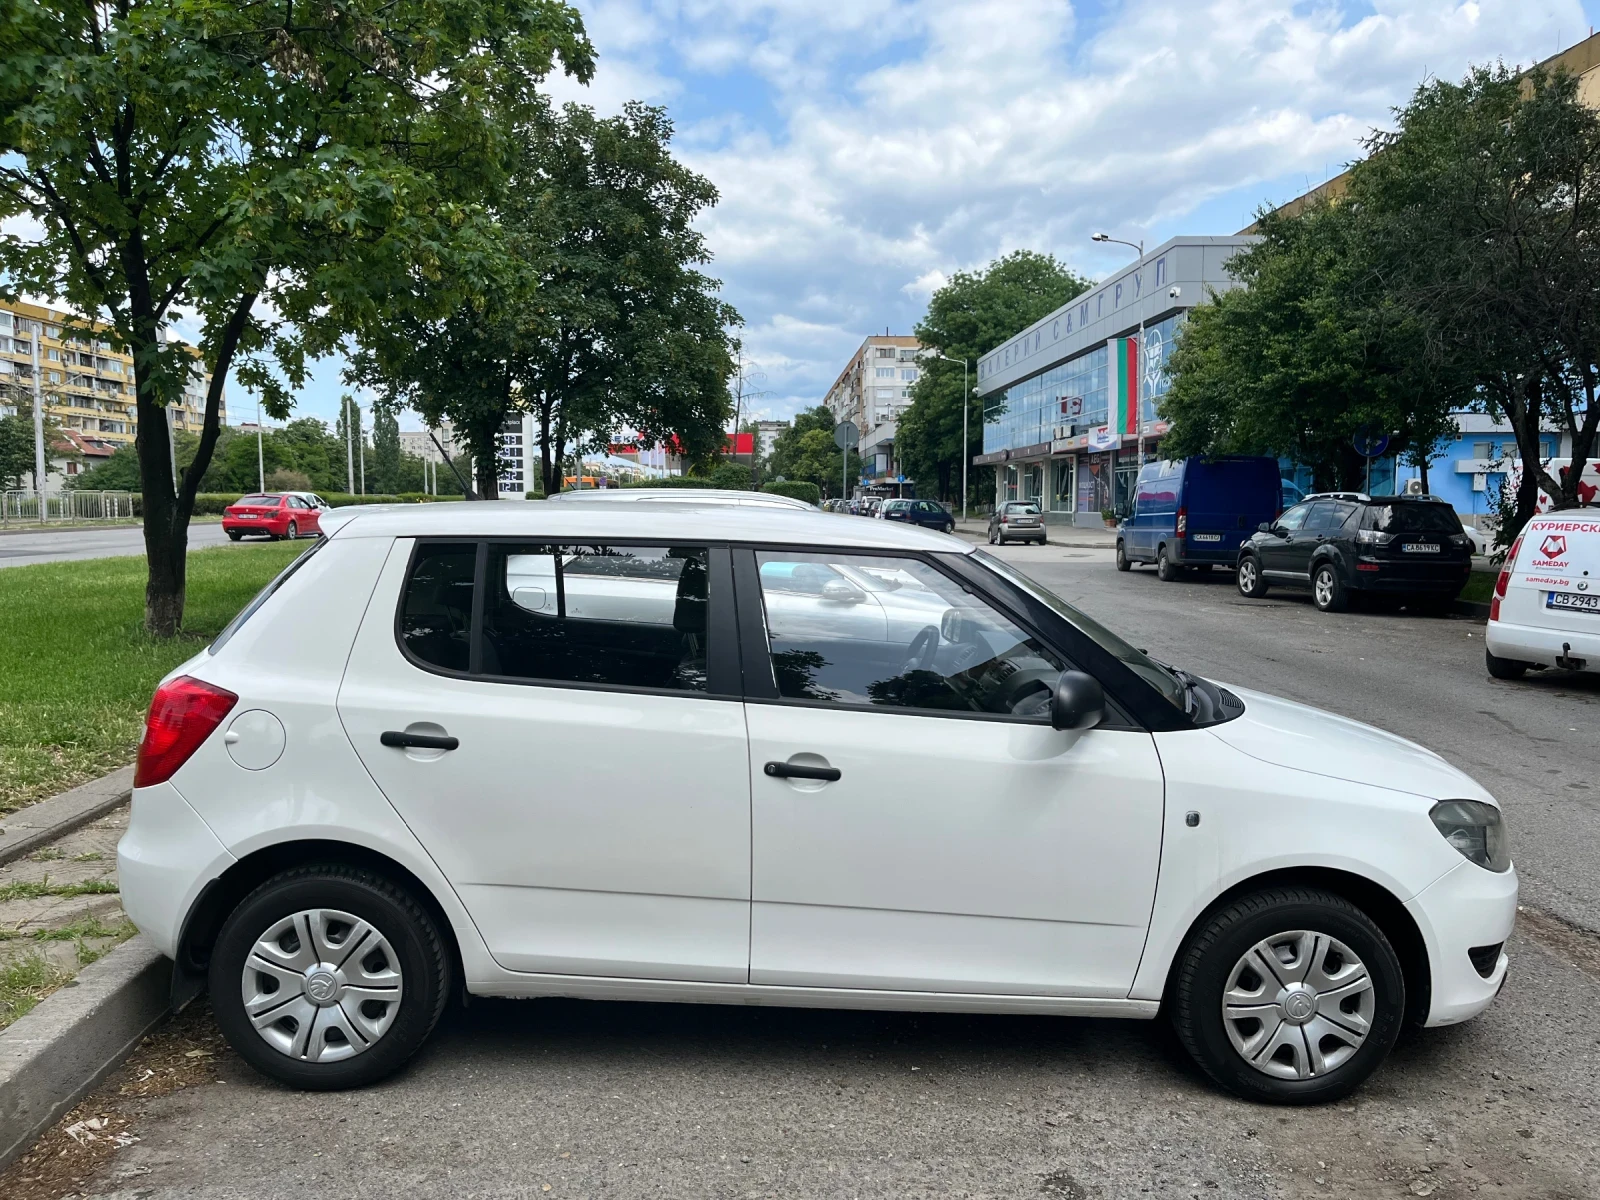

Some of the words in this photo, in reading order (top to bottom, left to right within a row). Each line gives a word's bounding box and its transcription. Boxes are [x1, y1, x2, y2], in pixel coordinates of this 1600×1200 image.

[1531, 522, 1600, 533] КУРИЕРСК
[1525, 577, 1570, 586] sameday.bg
[1555, 594, 1569, 604] CB
[1571, 596, 1598, 607] 2943
